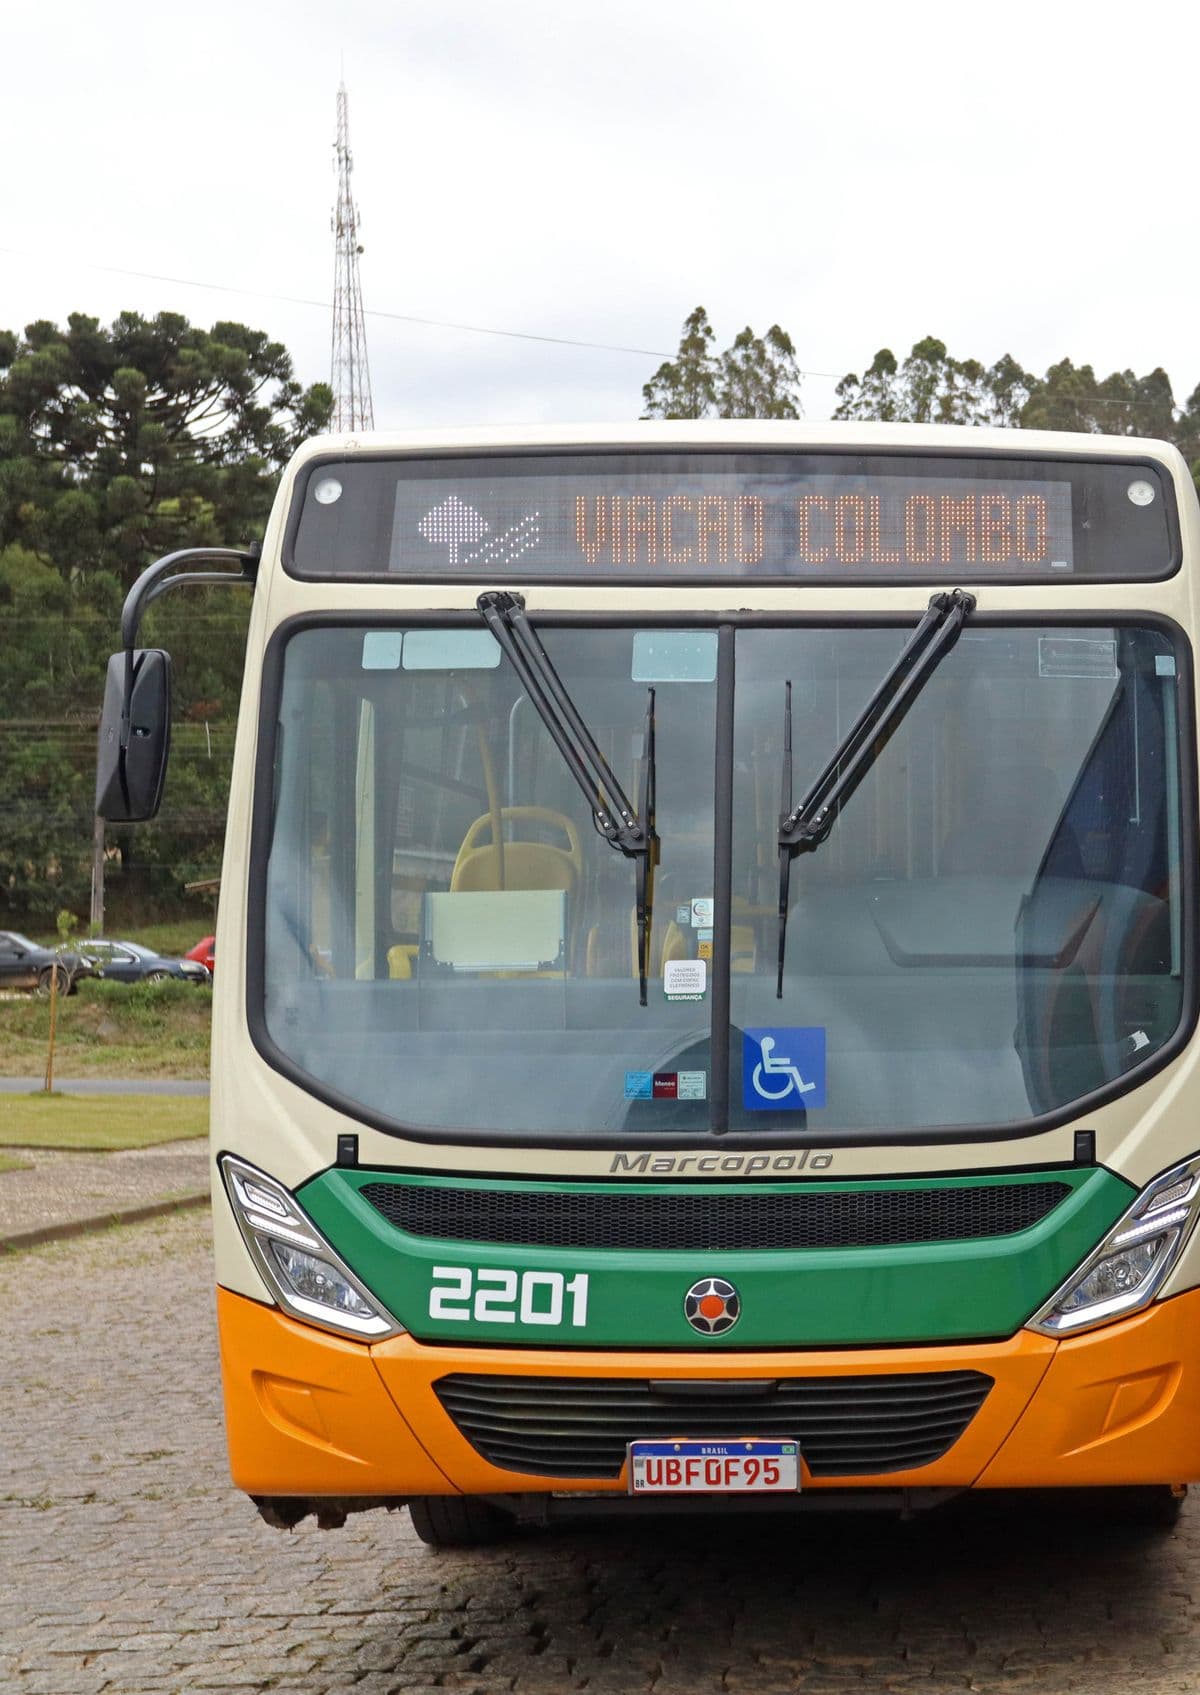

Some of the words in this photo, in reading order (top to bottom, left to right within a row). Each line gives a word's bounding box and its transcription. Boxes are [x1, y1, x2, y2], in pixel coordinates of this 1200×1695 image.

[576, 496, 763, 563] VIACAO
[800, 495, 1046, 563] COLOMBO
[609, 1150, 834, 1176] Marcopolo
[428, 1265, 590, 1328] 2201
[701, 1447, 729, 1455] BRASIL
[635, 1479, 645, 1489] BR
